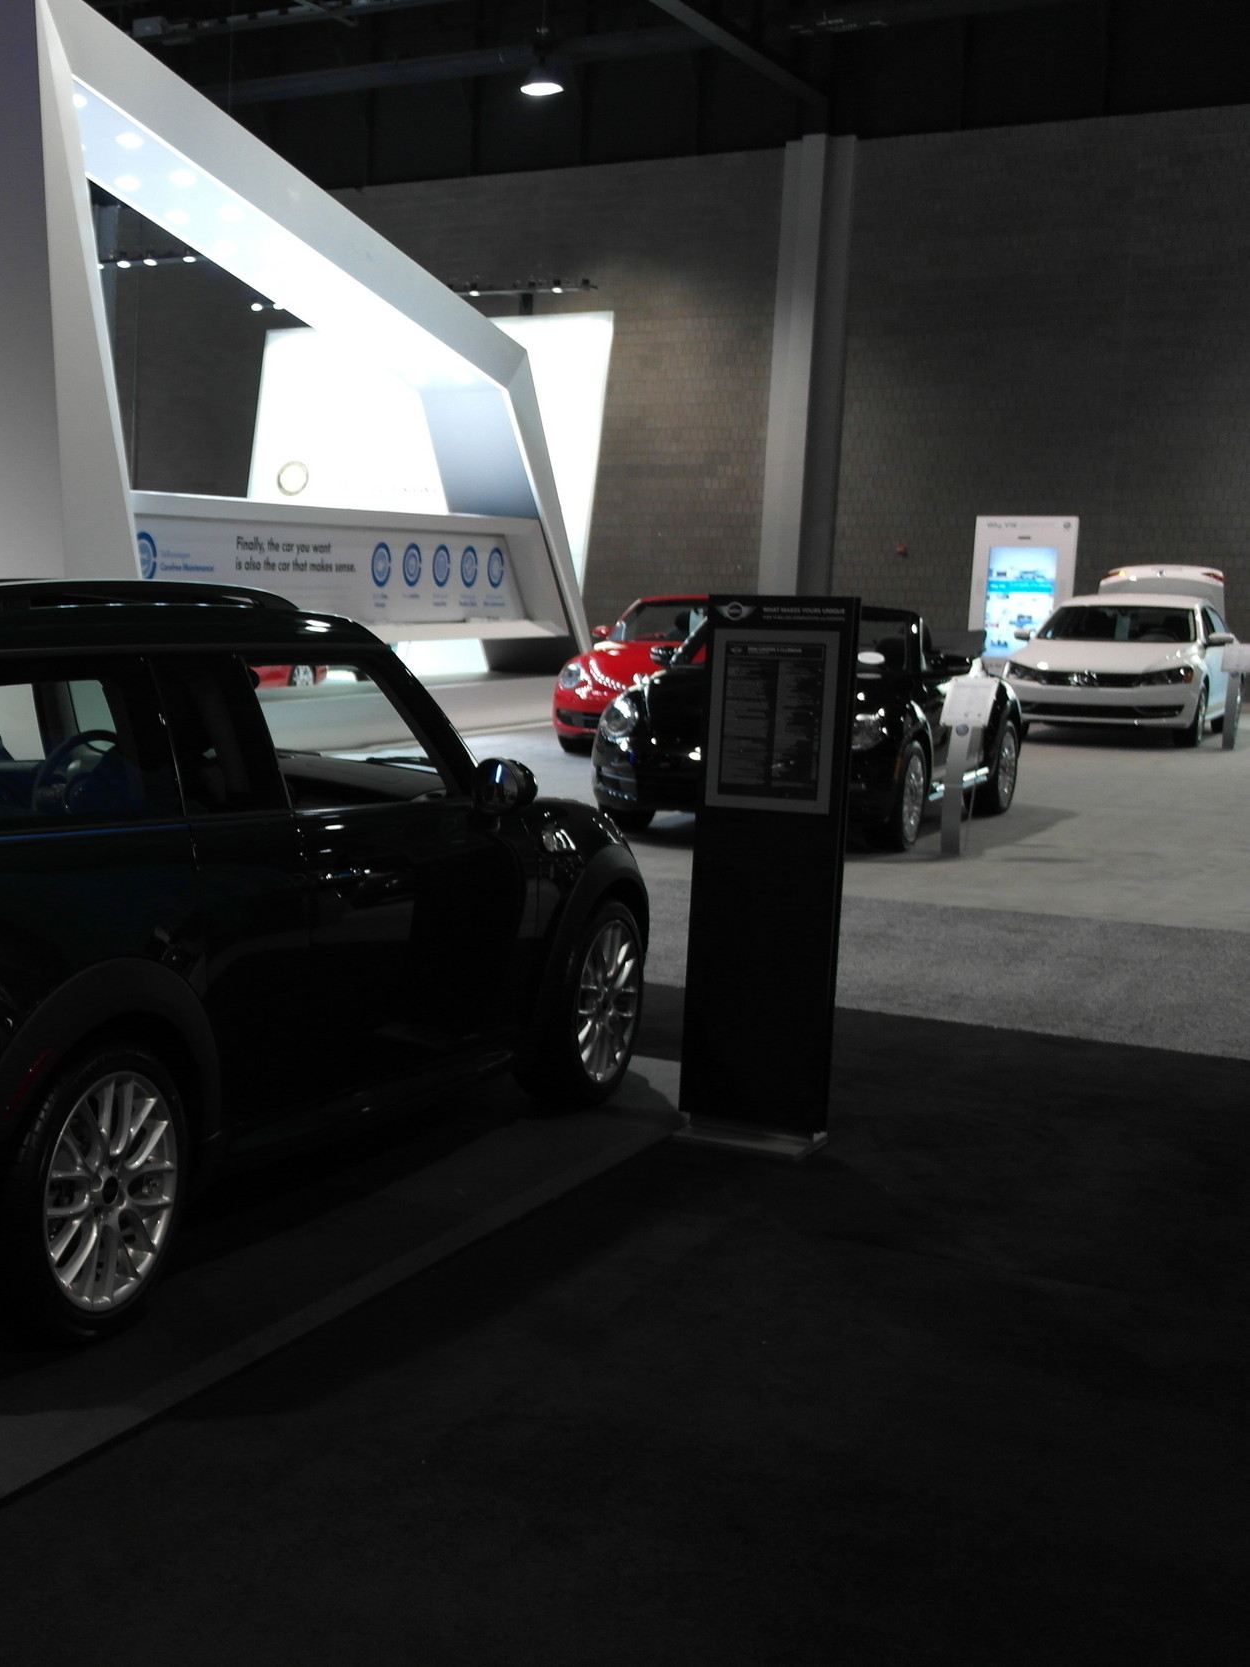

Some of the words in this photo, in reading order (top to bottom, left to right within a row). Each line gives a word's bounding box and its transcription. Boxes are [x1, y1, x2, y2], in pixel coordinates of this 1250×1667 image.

[236, 536, 265, 554] Finally,
[267, 538, 280, 552] the
[281, 542, 294, 552] car
[296, 543, 311, 555] you
[312, 542, 331, 554] want
[235, 557, 242, 570] is
[244, 557, 261, 571] also
[263, 557, 276, 571] the
[278, 561, 290, 572] car
[292, 558, 308, 572] that
[309, 558, 333, 572] makes
[334, 563, 356, 573] sense.
